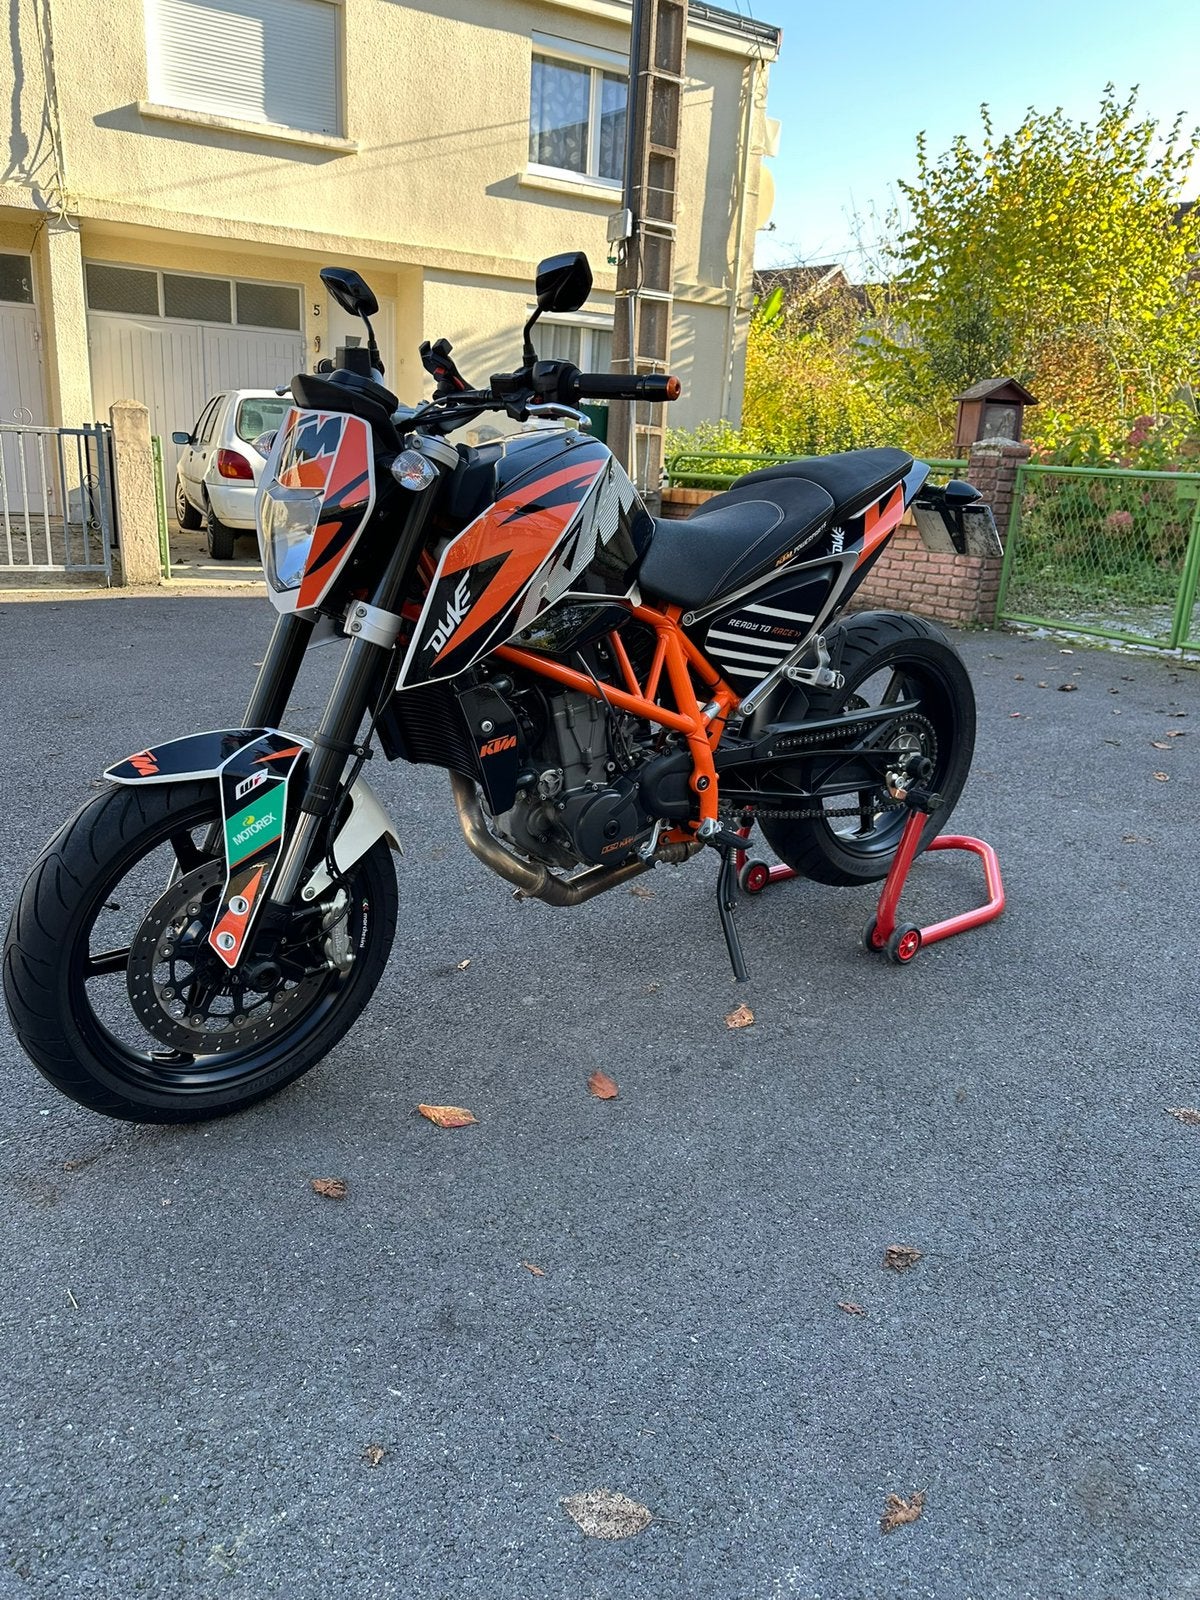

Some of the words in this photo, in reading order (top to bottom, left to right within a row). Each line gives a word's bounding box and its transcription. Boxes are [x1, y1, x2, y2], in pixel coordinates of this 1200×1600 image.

[313, 304, 321, 316] 5
[832, 526, 845, 554] DUKE
[422, 567, 472, 653] DUKE
[727, 618, 760, 631] READY
[759, 624, 772, 633] TO
[771, 626, 793, 637] RACE
[480, 734, 517, 758] KTM
[232, 811, 277, 846] MOTOREX
